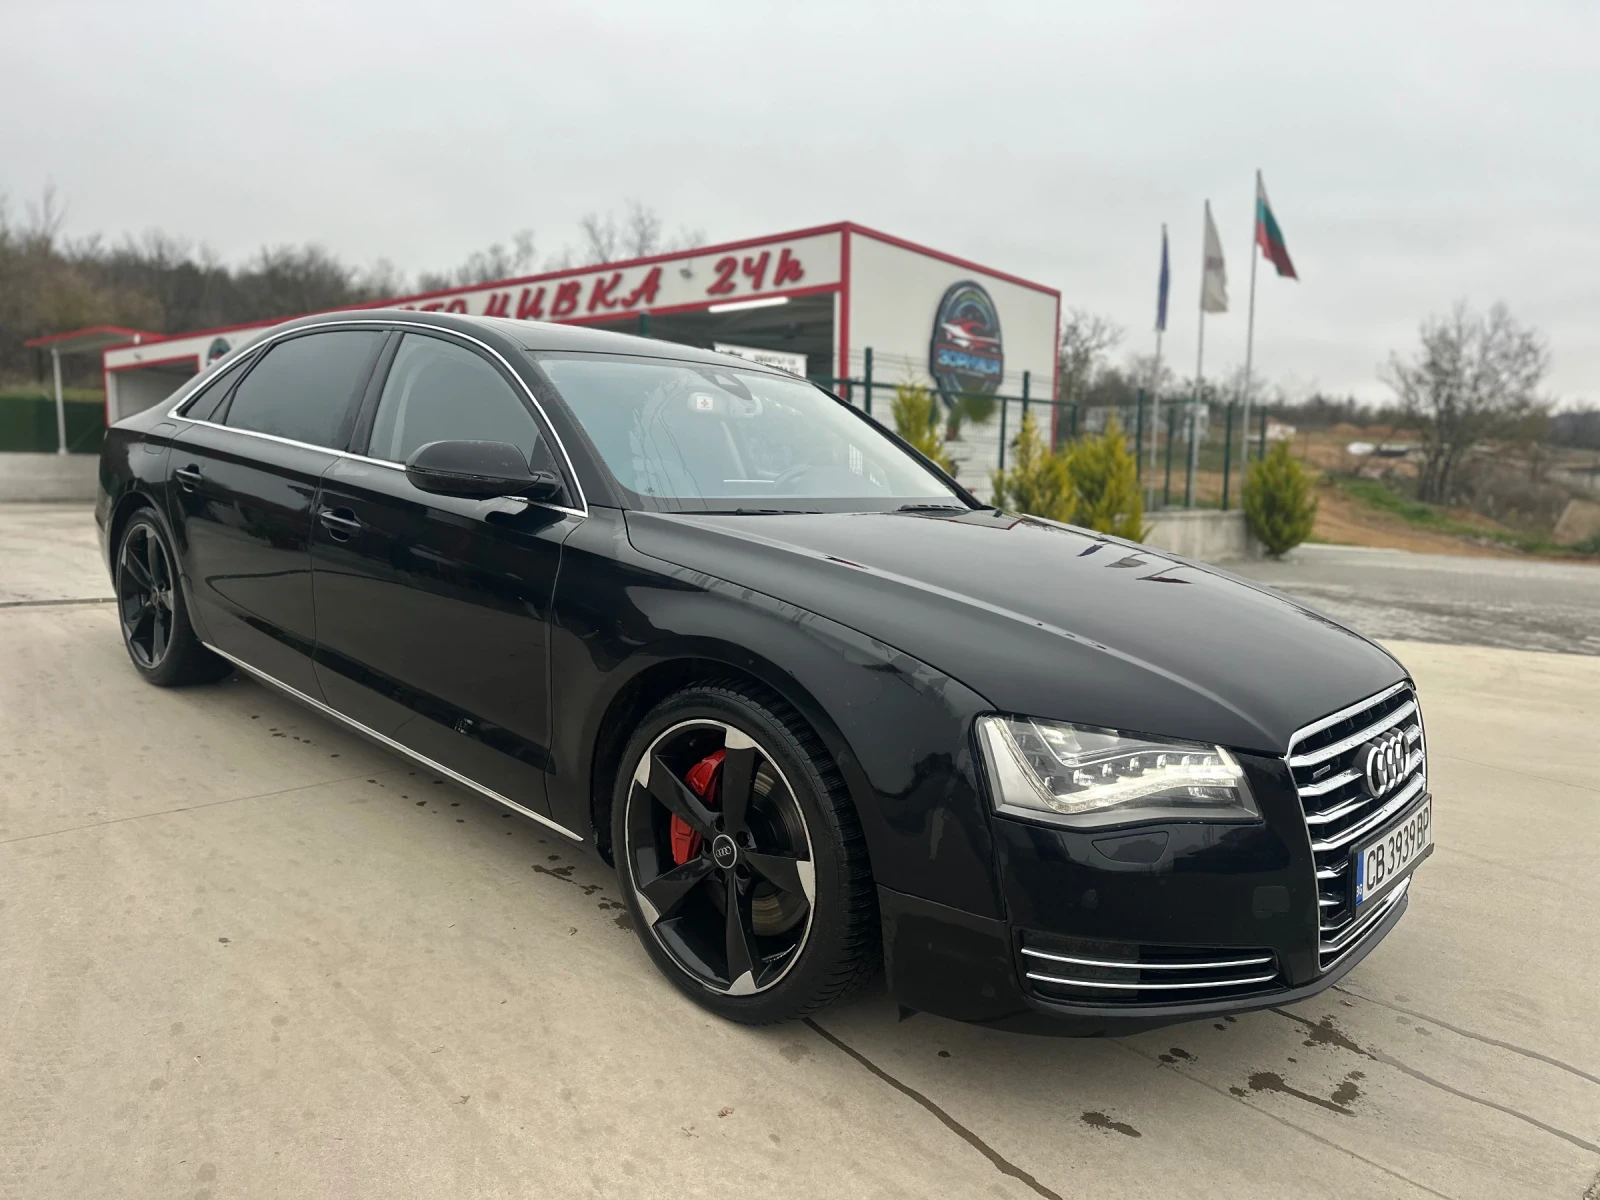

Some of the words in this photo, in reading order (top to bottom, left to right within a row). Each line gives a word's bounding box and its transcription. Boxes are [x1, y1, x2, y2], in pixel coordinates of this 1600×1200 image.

[706, 248, 804, 295] 24h
[1366, 843, 1385, 891] CB
[1388, 819, 1416, 875] 3939
[1417, 806, 1429, 851] BP
